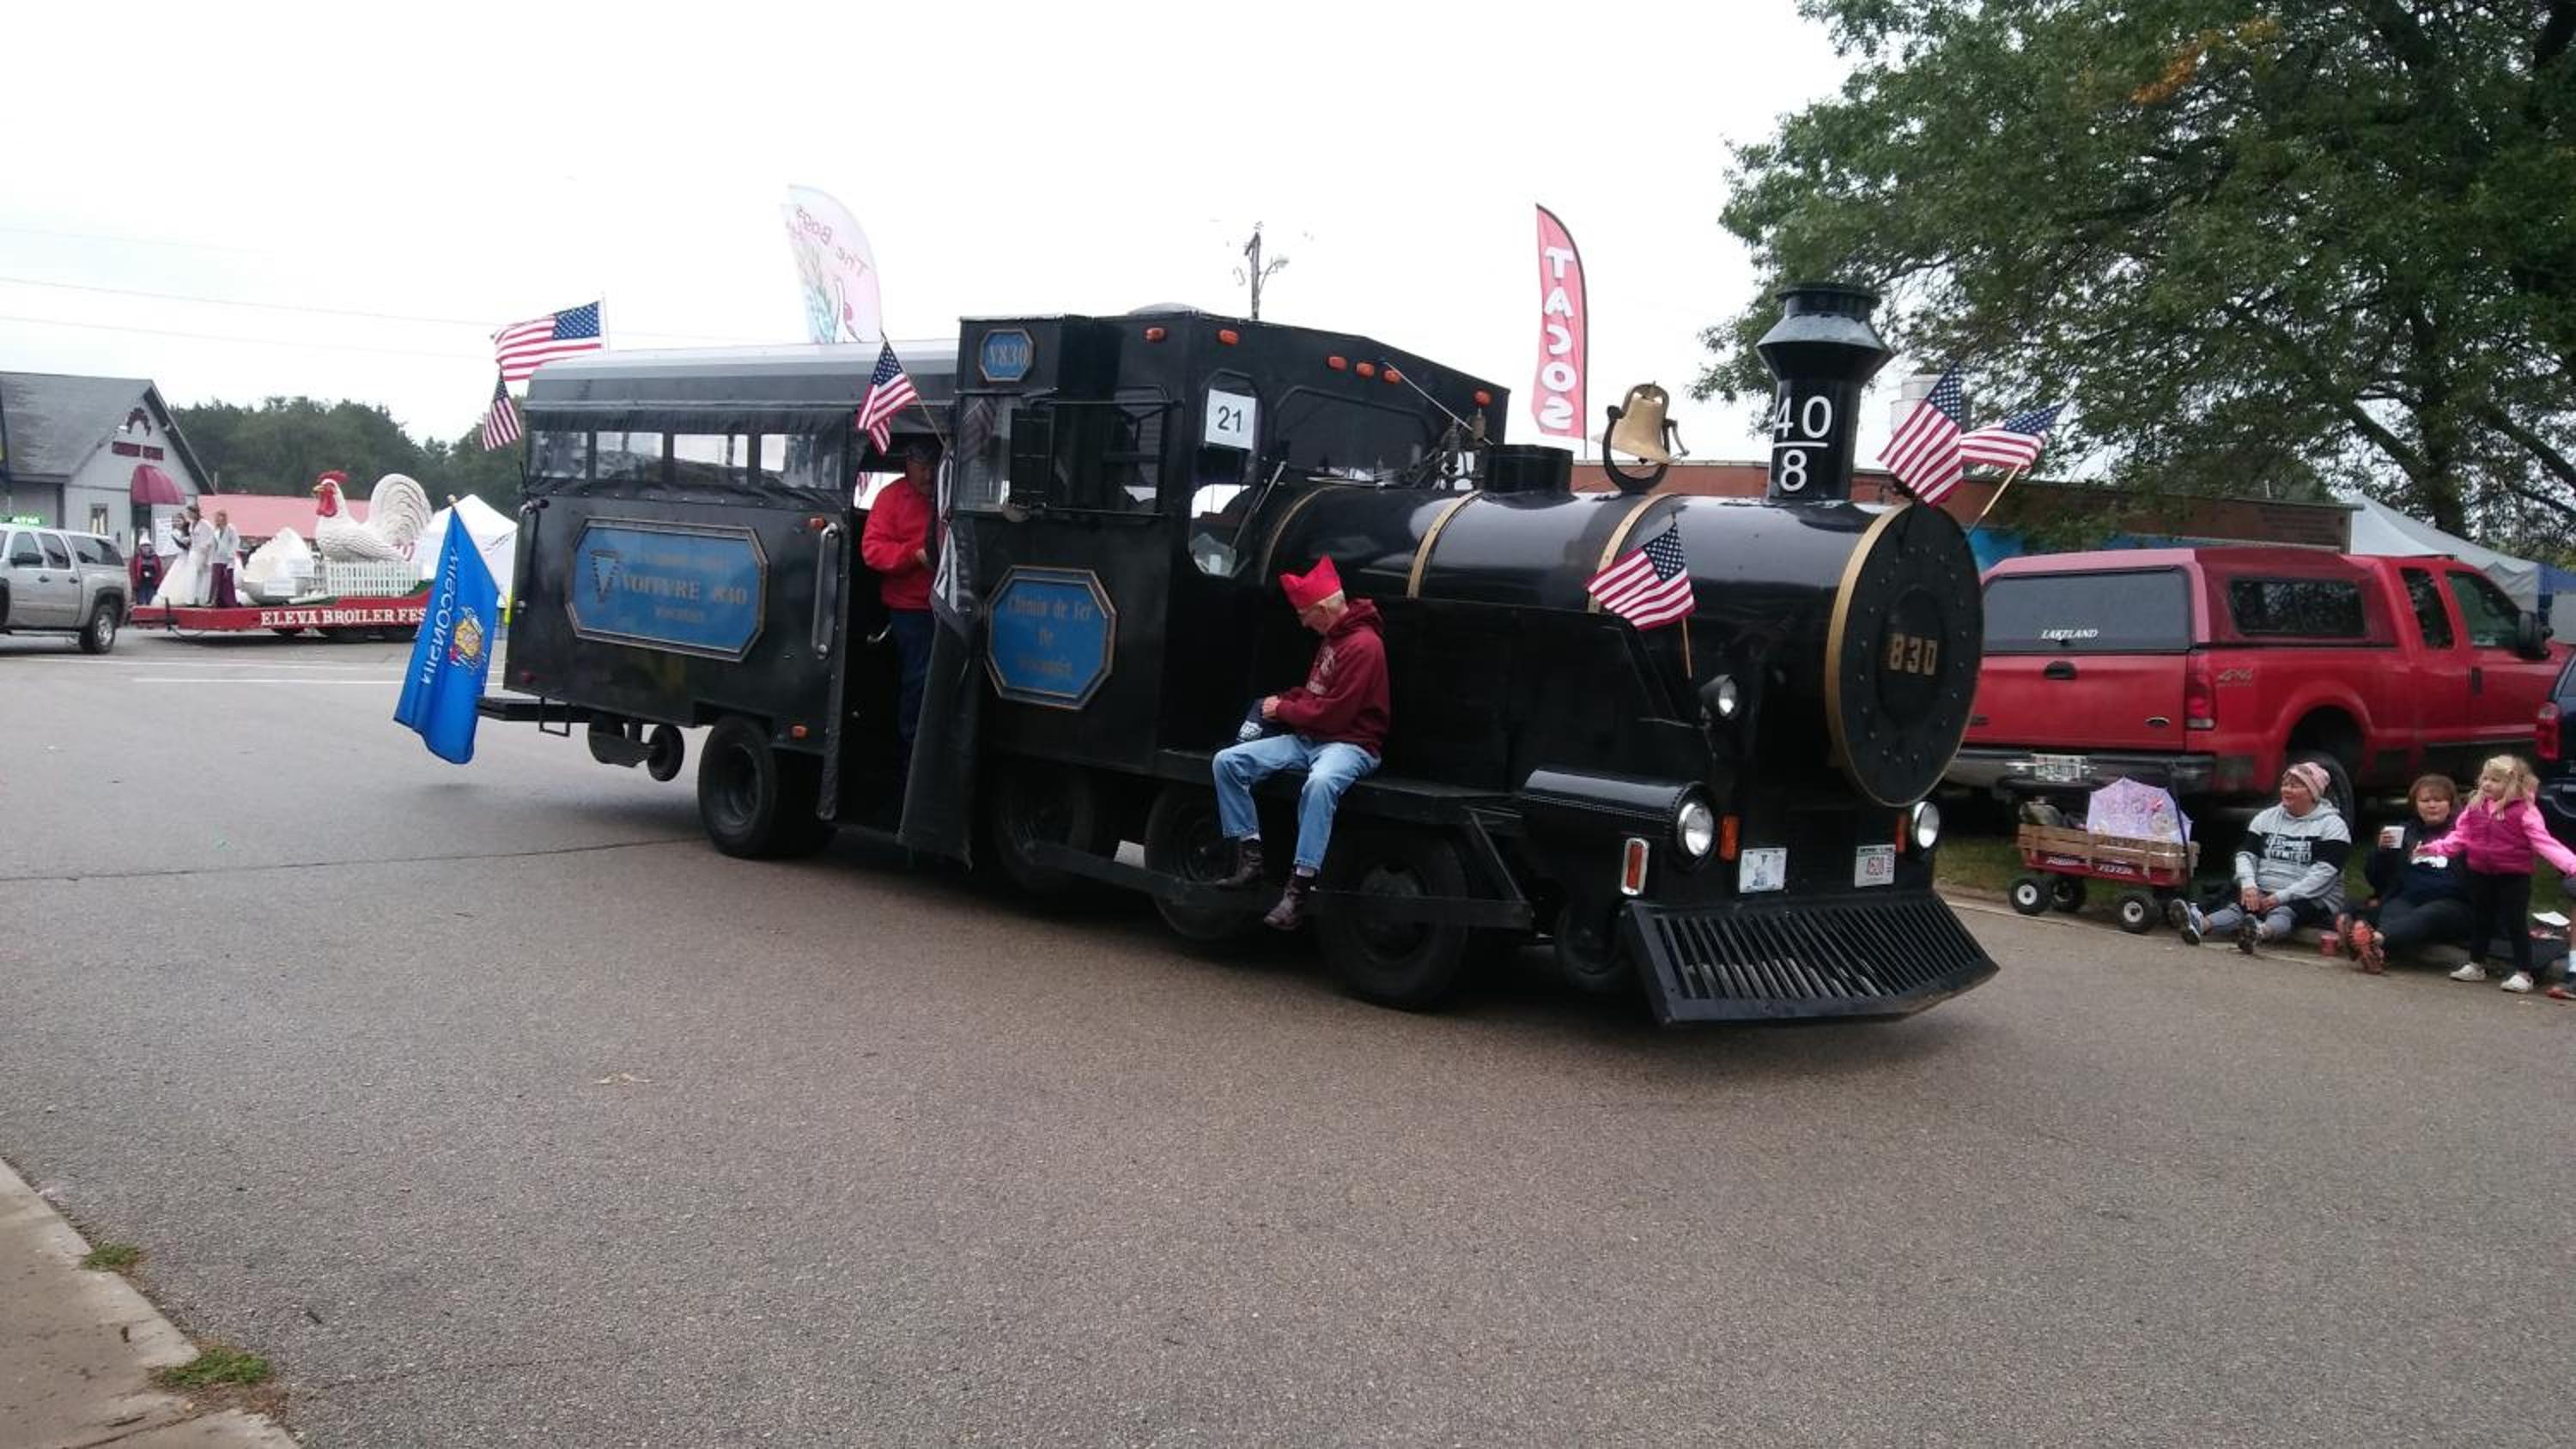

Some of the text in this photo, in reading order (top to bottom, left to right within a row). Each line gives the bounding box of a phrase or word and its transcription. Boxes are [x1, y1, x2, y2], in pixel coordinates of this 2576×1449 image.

[1218, 405, 1242, 433] 21
[1774, 396, 1832, 439] 40
[1780, 449, 1807, 492] 8
[260, 610, 319, 626] ELEVA
[322, 608, 395, 625] BROILER
[1888, 633, 1938, 676] 830
